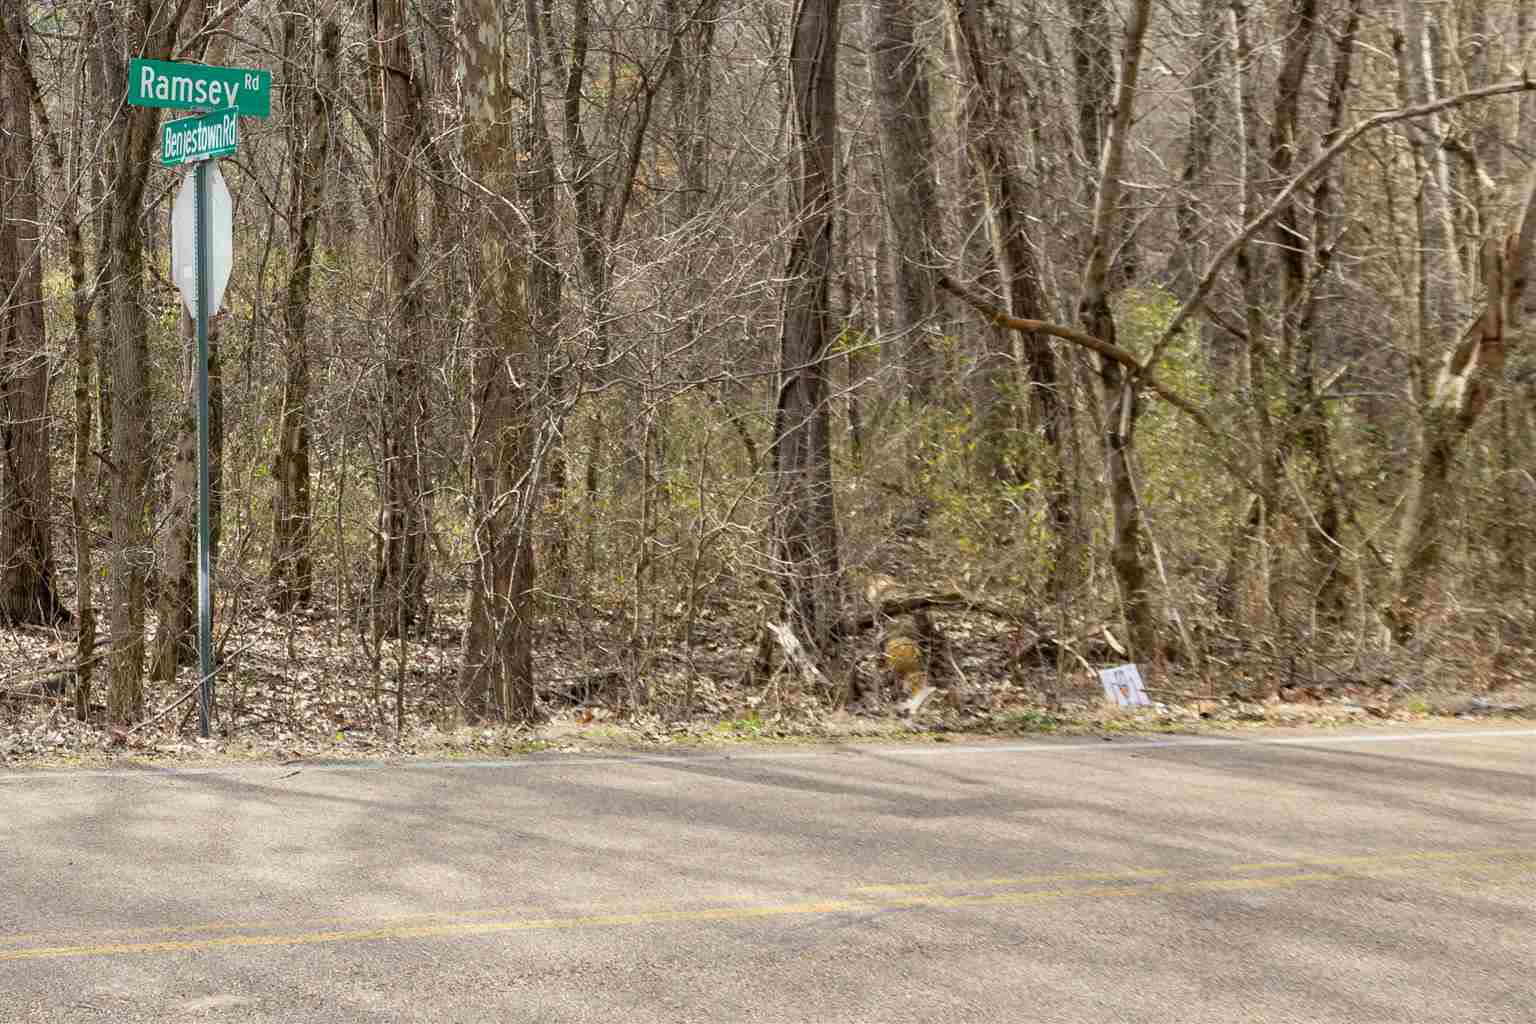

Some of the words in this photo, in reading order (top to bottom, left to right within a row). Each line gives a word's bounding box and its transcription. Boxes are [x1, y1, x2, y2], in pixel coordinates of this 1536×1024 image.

[140, 66, 240, 108] Ramsey
[244, 73, 260, 91] Rd
[165, 123, 221, 162] Benjestown
[223, 114, 237, 146] Rd
